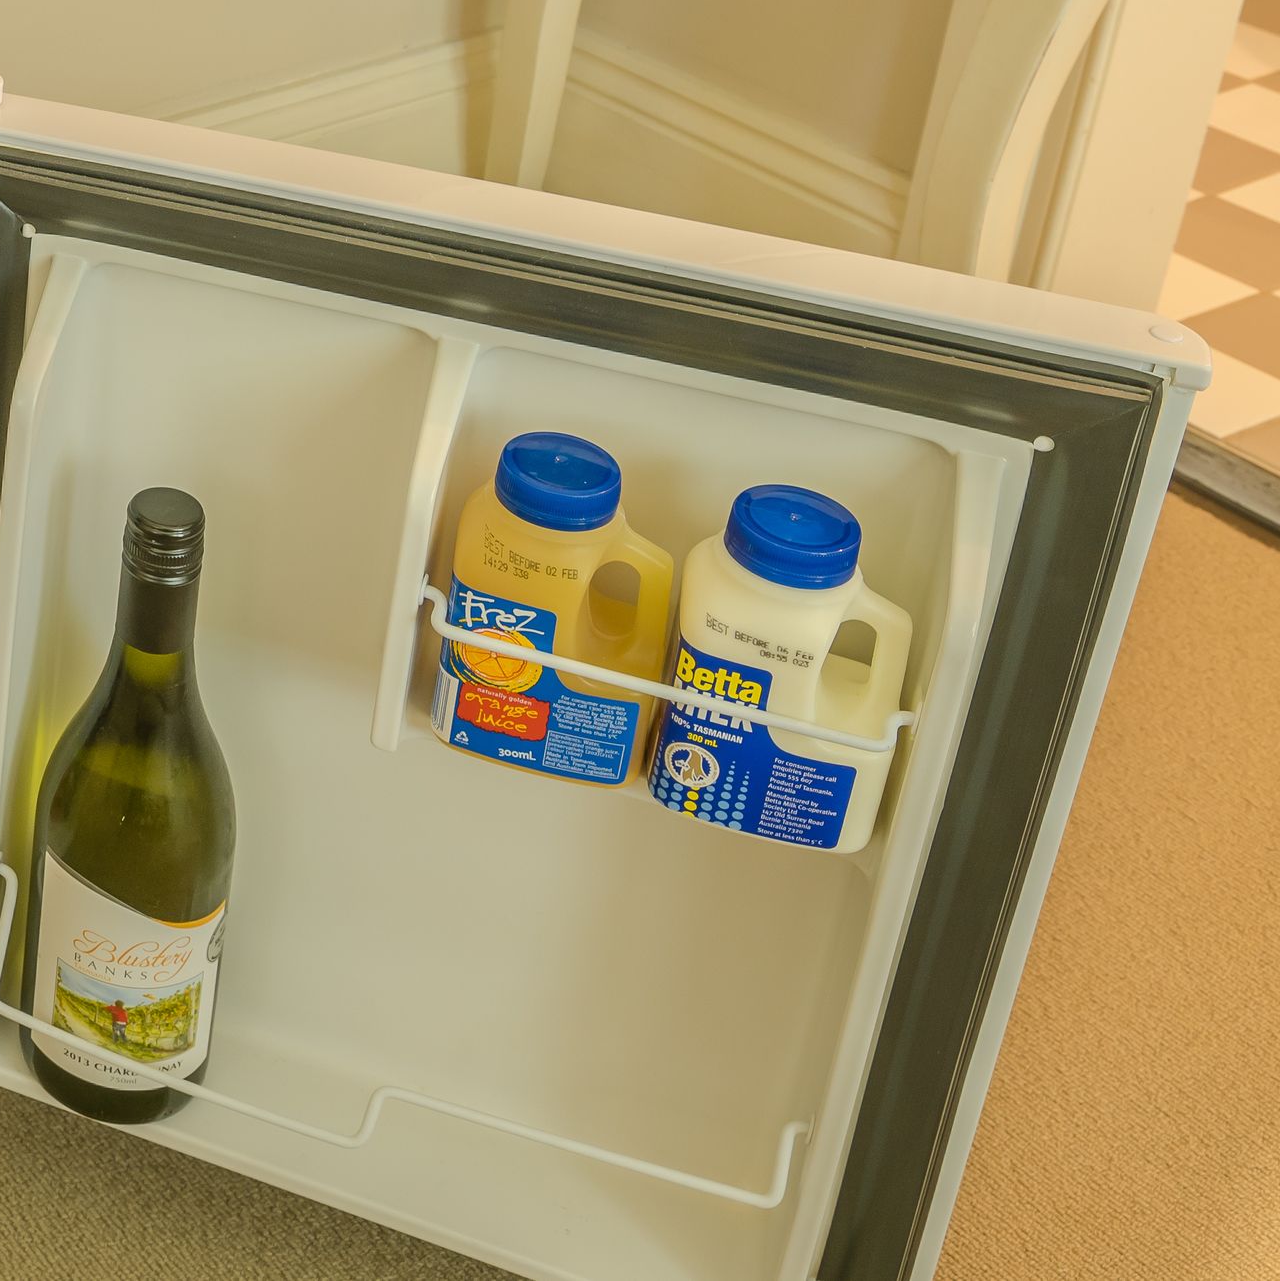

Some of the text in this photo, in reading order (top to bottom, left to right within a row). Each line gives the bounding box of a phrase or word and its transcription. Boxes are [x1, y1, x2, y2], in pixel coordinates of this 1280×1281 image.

[484, 553, 529, 579] 14:29 338
[509, 550, 540, 573] BEFORE
[546, 566, 557, 577] 02
[562, 568, 578, 580] FEB
[706, 612, 729, 636] BEST
[734, 630, 770, 649] BEFORE
[760, 650, 788, 663] 08:55
[676, 648, 763, 704] Betta
[465, 692, 538, 718] orange
[477, 688, 532, 706] naturally golden
[476, 708, 527, 733] juice
[671, 712, 743, 744] 100% TASMANIAN
[687, 732, 718, 747] 300 mL
[498, 748, 536, 761] 300mL
[773, 764, 802, 775] enquiries
[803, 772, 824, 781] please
[786, 762, 816, 772] consumer
[772, 770, 787, 778] 1300
[788, 774, 799, 782] 555
[768, 783, 796, 795] Australia
[770, 777, 794, 788] Product
[803, 785, 833, 797] Tasmania,
[765, 796, 782, 805] Betta
[798, 805, 837, 817] Co-operative
[766, 790, 809, 806] Manufactured
[764, 802, 786, 813] Society
[759, 820, 804, 835] Australia 7320
[761, 814, 811, 830] Burnie Tasmania
[786, 814, 807, 824] Surrey
[808, 819, 825, 827] Road
[782, 833, 795, 841] less
[796, 836, 810, 844] than
[72, 929, 193, 982] Blustery
[74, 952, 148, 980] BANKS
[63, 1048, 183, 1076] 2013 CHARNAY
[112, 1077, 137, 1085] 750ml
